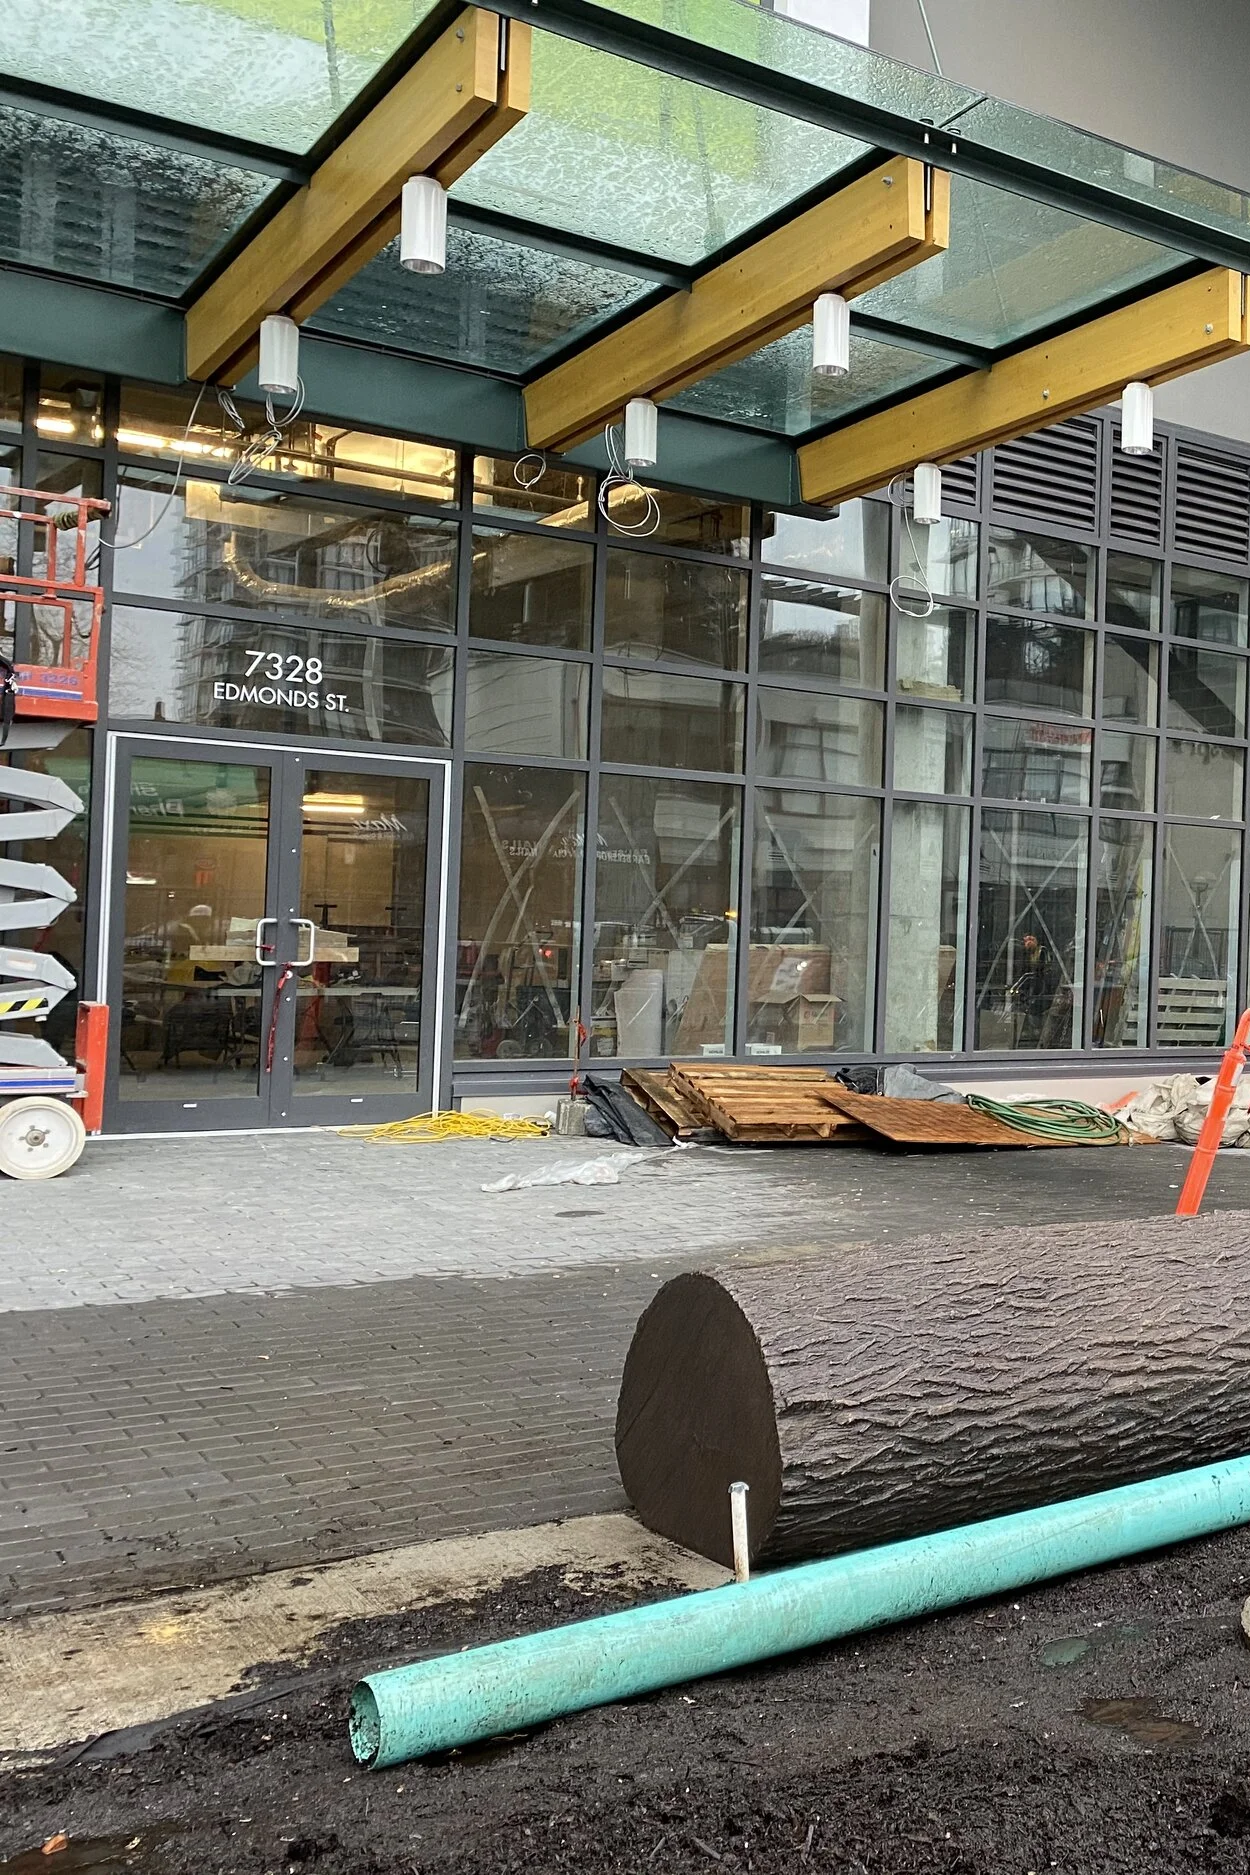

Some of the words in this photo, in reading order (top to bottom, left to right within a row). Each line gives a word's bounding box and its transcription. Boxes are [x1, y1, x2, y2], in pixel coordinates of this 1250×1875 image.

[244, 650, 323, 685] 7328
[213, 681, 319, 709] EDMONDS
[325, 694, 349, 712] ST.
